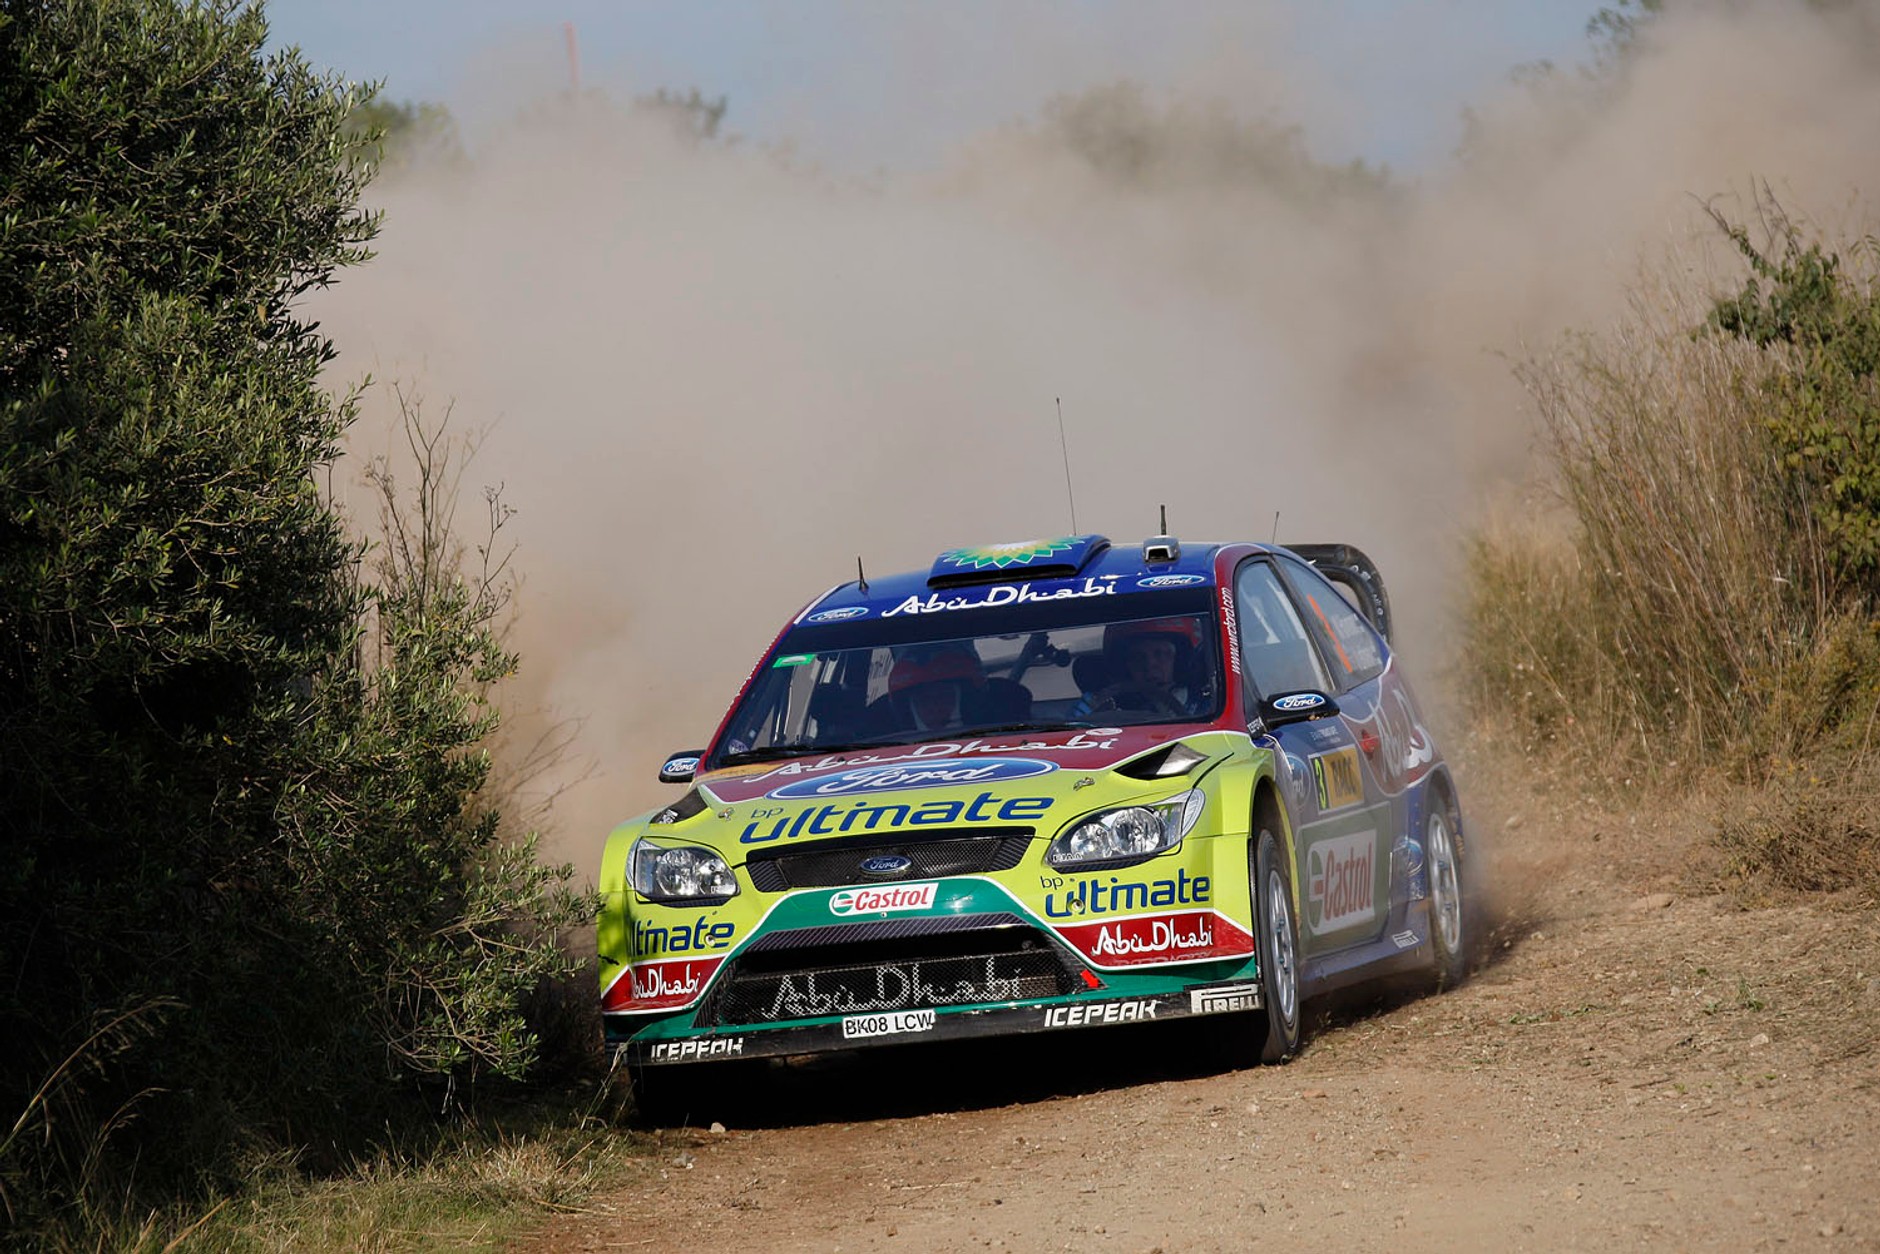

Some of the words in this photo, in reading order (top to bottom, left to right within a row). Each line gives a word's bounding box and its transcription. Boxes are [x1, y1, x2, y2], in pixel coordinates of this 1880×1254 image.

[881, 593, 970, 618] Abu
[980, 577, 1117, 607] Dhabi
[1152, 576, 1194, 587] Ford
[817, 608, 859, 621] Ford
[1283, 694, 1317, 708] Ford
[667, 760, 699, 772] Ford
[744, 756, 883, 783] Abu
[908, 734, 1120, 758] Dhabi
[816, 761, 1003, 794] Ford
[1314, 758, 1327, 810] 3
[739, 792, 1055, 845] ultimate
[750, 806, 784, 820] bp
[869, 858, 900, 870] Ford
[1040, 876, 1064, 890] bp
[1045, 868, 1211, 918] ultimate
[1323, 841, 1373, 922] Castrol
[855, 887, 930, 911] Castrol
[631, 916, 735, 957] ltimate
[1091, 924, 1147, 957] Abu
[1150, 916, 1214, 950] Dhabi
[647, 963, 701, 998] Dhabi
[761, 973, 856, 1020] Abu
[872, 956, 1023, 1009] Dhabi
[1044, 1000, 1161, 1028] ICEPEAK
[1190, 983, 1260, 1014] PIRELLI
[845, 1016, 889, 1036] BK08
[895, 1011, 935, 1032] LCW
